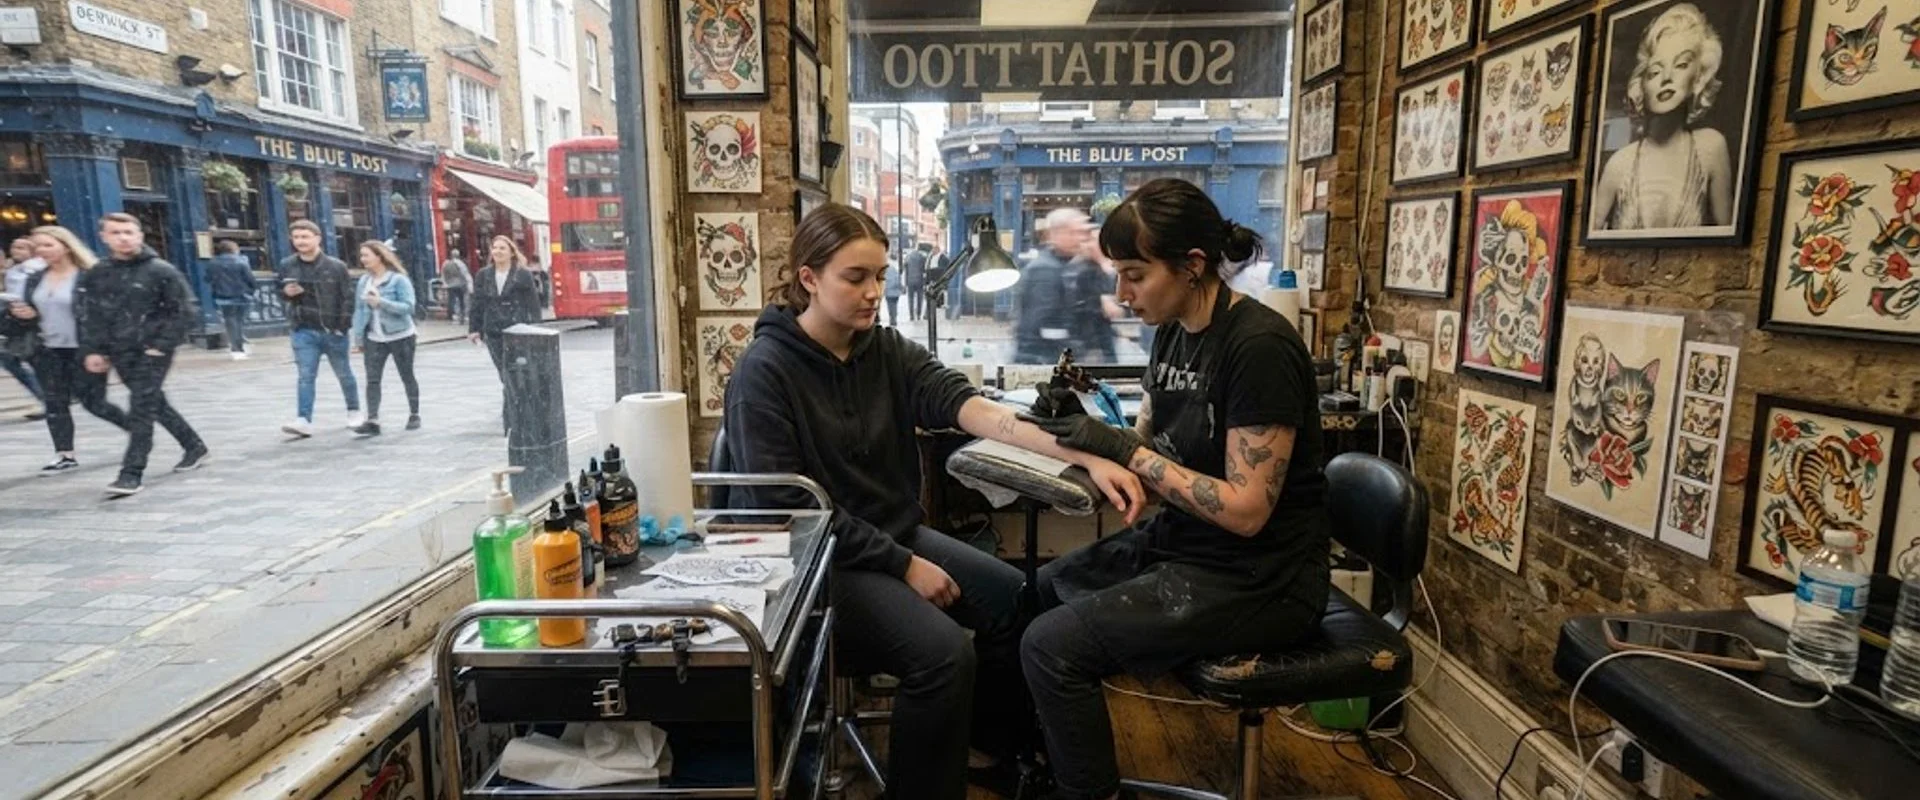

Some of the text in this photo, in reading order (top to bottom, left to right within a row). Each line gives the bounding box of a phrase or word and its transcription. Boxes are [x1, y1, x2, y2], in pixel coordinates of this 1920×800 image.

[146, 26, 161, 40] ST
[254, 135, 389, 173] THE BLUE POST
[1046, 146, 1188, 163] THE BLUE POST
